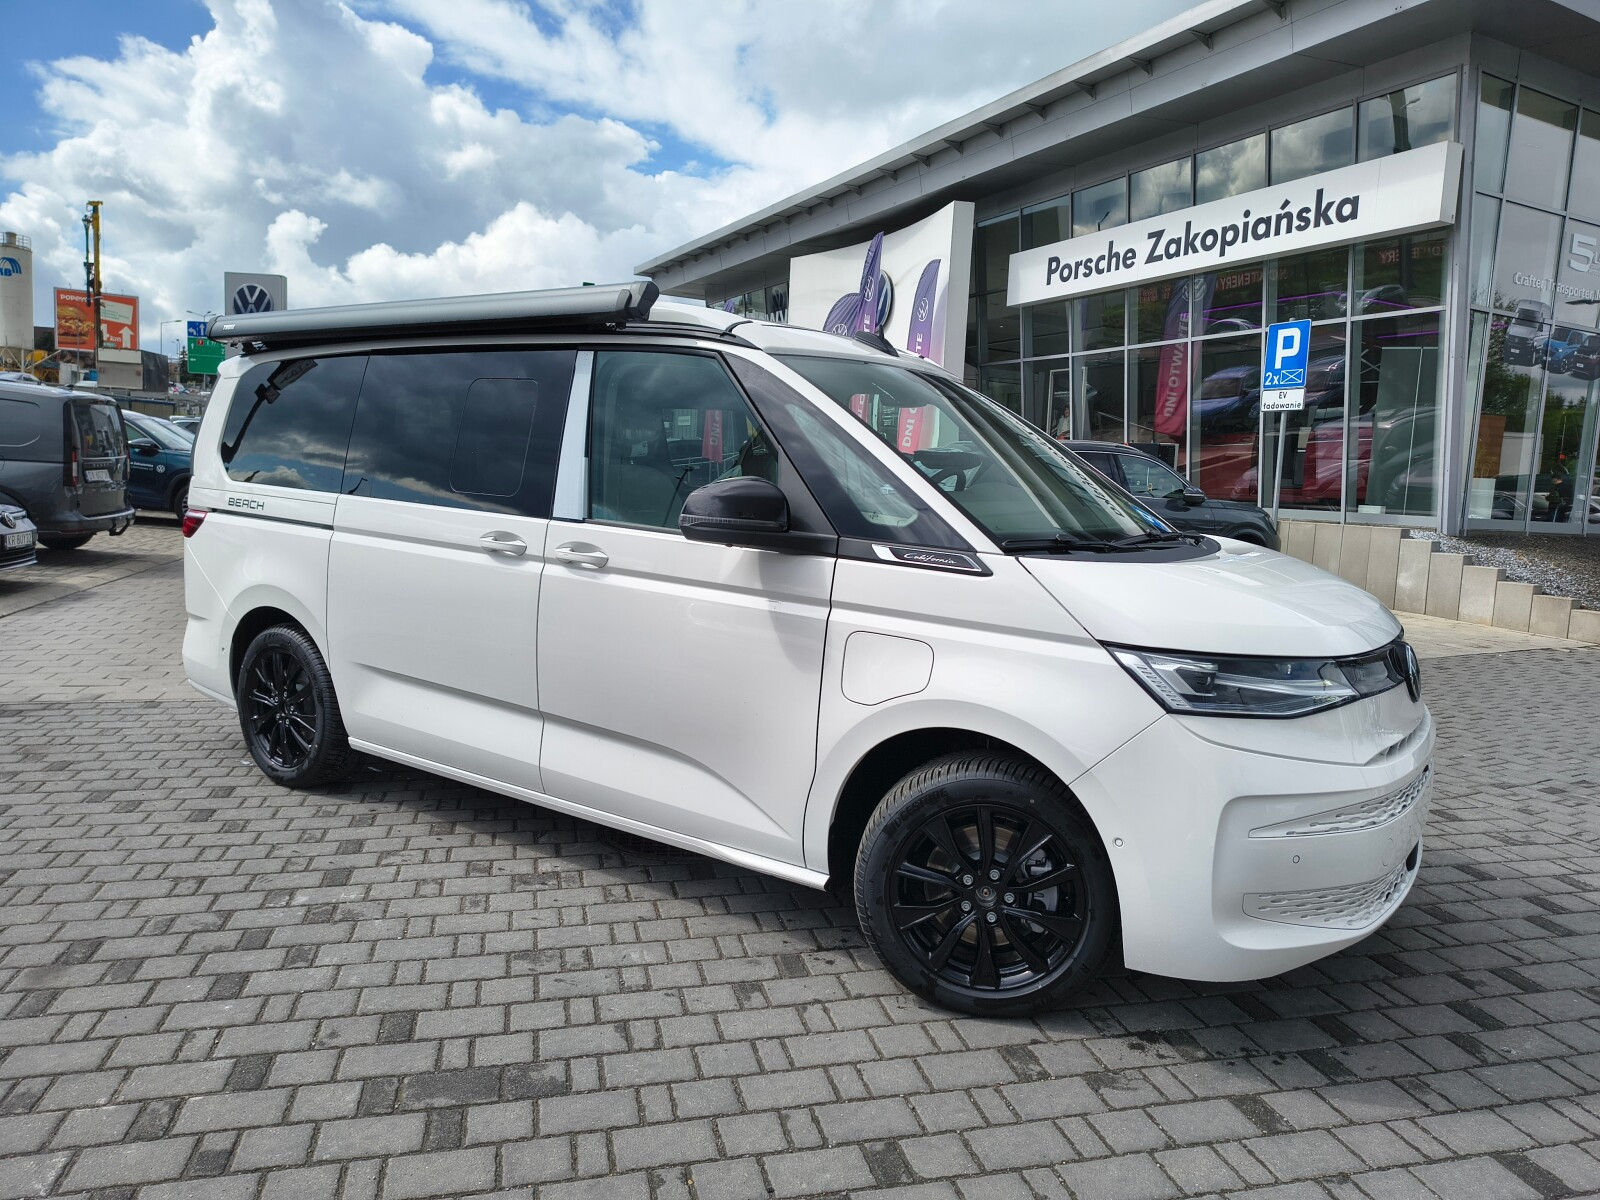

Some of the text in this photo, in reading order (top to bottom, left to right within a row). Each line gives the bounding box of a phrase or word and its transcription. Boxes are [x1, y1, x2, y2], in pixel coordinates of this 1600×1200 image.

[1046, 188, 1360, 286] Porsche Zakopiańska
[1570, 233, 1597, 272] 5
[1274, 327, 1301, 369] P
[1278, 391, 1288, 399] EV
[901, 418, 916, 448] DNI
[227, 497, 265, 511] BEACH
[903, 552, 957, 565] California
